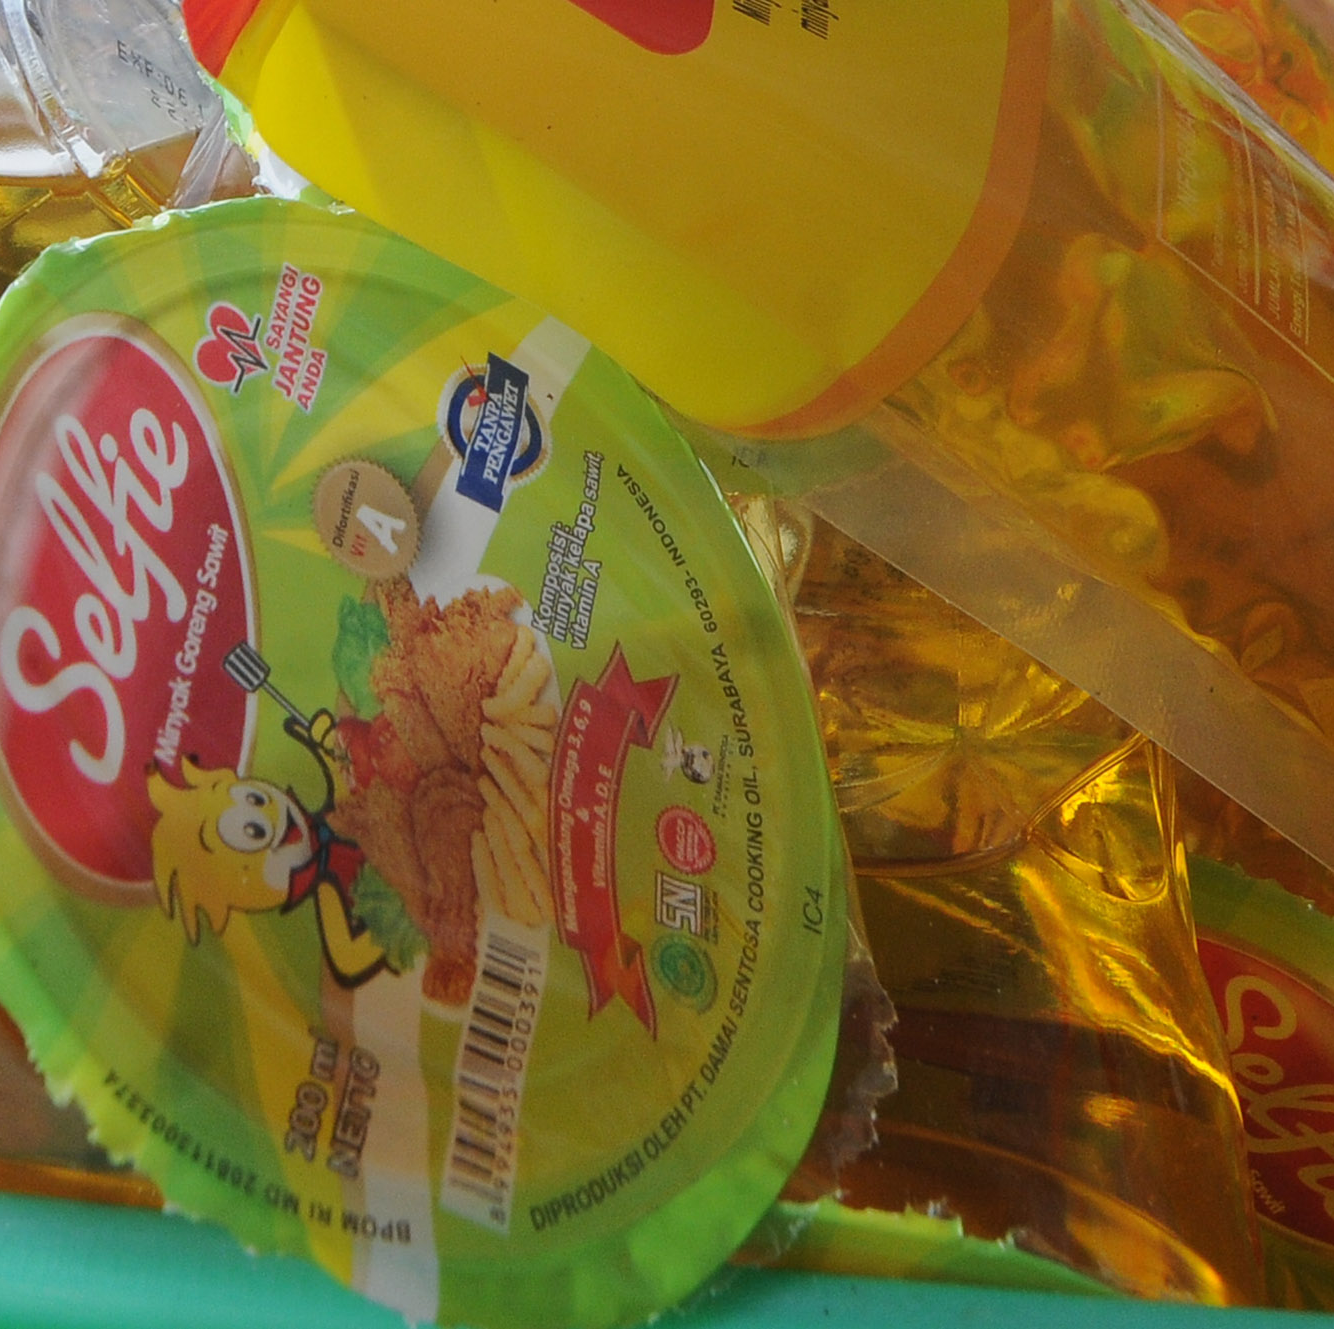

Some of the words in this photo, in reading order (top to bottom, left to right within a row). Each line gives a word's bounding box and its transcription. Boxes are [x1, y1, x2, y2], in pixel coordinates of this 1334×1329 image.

[267, 266, 299, 350] SAYANGI
[275, 275, 322, 397] JANTUNG
[296, 350, 326, 411] ANDA
[474, 392, 502, 453] TANPA
[483, 380, 519, 484] PENGAWET
[332, 471, 360, 549] Difortifikasi
[350, 535, 366, 557] Vit
[356, 504, 407, 555] A
[617, 464, 686, 568] INDONESIA
[0, 408, 189, 784] Selfie
[531, 522, 569, 634] Komposisi:
[552, 568, 578, 642] minyak
[569, 505, 595, 568] kelapa
[584, 560, 602, 577] A
[155, 676, 192, 767] Minyak
[176, 593, 217, 671] Goreng
[197, 523, 229, 587] Sawit
[571, 579, 599, 650] vitamin
[578, 699, 593, 713] 9
[712, 643, 755, 758] SURABAYA
[559, 749, 580, 809] Omega
[559, 814, 579, 933] Mengandung
[592, 820, 613, 889] Vitamin
[747, 810, 764, 914] COOKING
[660, 874, 701, 936] SNI
[802, 885, 826, 936] IC4
[734, 918, 762, 1017] SENTOSA
[507, 966, 542, 1071] 000391
[699, 1016, 738, 1086] DAMAI
[284, 1081, 329, 1163] 200
[328, 1045, 380, 1180] NETTO
[642, 1106, 688, 1160] OLEH
[680, 1080, 707, 1116] PT.
[265, 1182, 300, 1215] MD
[309, 1201, 332, 1226] RI
[341, 1212, 411, 1244] BPOM
[529, 1151, 645, 1231] DIPRODUKSI
